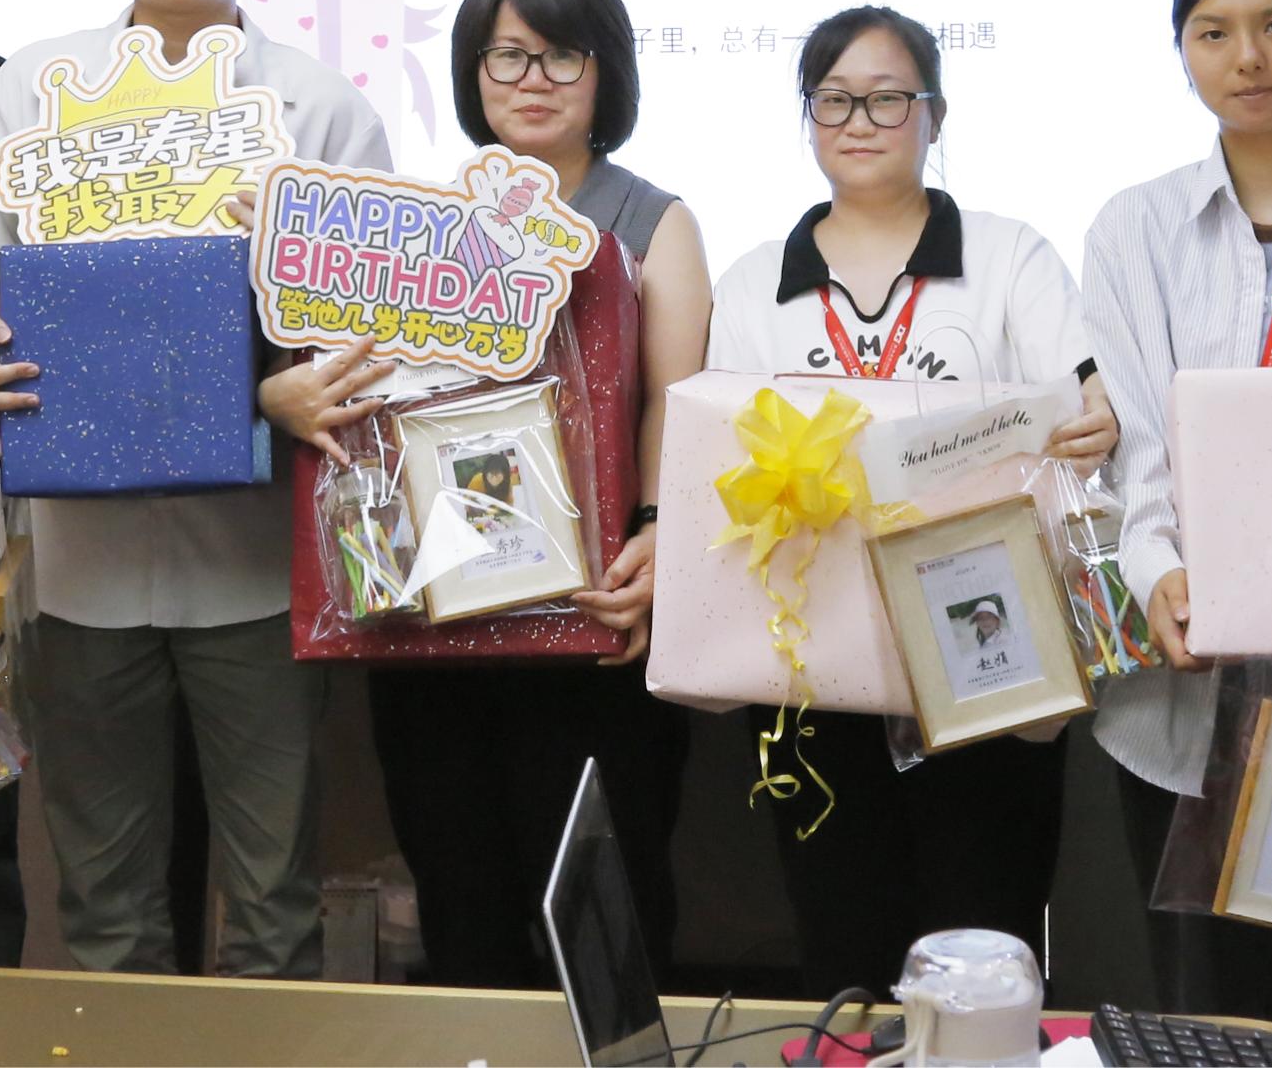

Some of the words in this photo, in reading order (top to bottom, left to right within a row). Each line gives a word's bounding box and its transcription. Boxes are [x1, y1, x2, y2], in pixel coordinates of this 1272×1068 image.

[106, 86, 163, 110] HAPPY
[10, 102, 273, 197] 我是寿星
[39, 164, 260, 241] 我最大
[279, 182, 458, 257] HAPPY
[275, 235, 548, 324] BIRTHDAT
[277, 286, 528, 364] 管他几岁开心万岁
[898, 449, 927, 468] You
[931, 433, 958, 458] had
[961, 431, 981, 447] me
[998, 410, 1032, 432] hello
